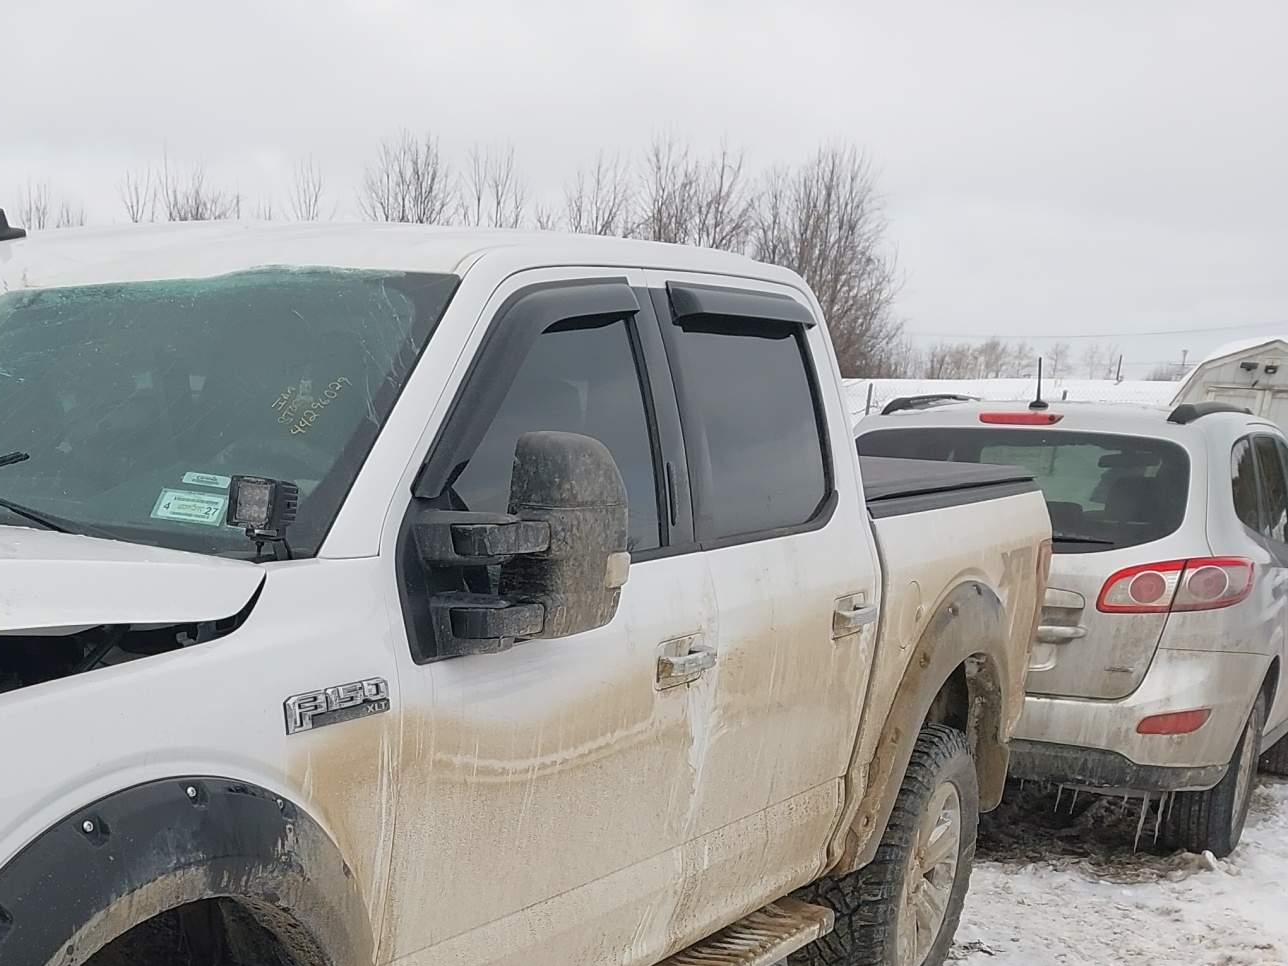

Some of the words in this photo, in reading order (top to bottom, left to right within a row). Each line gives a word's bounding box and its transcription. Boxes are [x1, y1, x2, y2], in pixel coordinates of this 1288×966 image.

[290, 376, 353, 435] 44296029
[203, 506, 219, 517] 27
[367, 701, 387, 714] XLT
